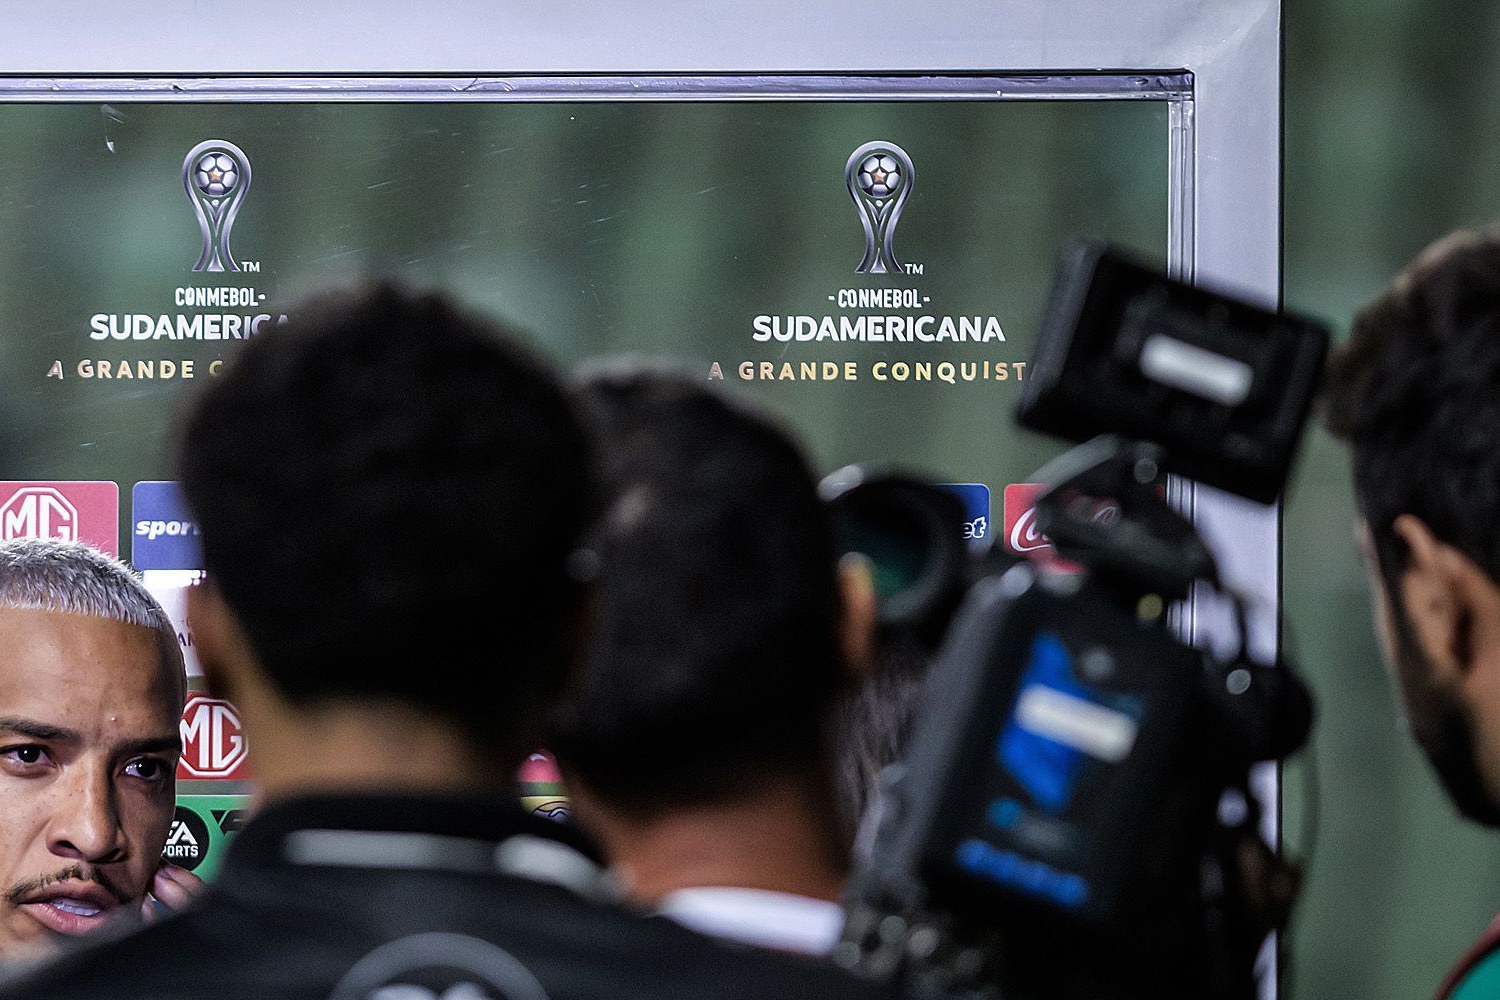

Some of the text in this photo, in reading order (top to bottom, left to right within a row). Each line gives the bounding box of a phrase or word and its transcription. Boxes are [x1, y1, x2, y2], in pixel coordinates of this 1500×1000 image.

[242, 261, 260, 273] TM
[904, 263, 924, 275] TM
[752, 315, 1006, 343] SUDAMERICANA
[46, 360, 64, 380] A
[76, 359, 195, 379] GRANDE
[707, 361, 724, 381] A
[738, 361, 859, 381] GRANDE
[180, 705, 243, 770] MG
